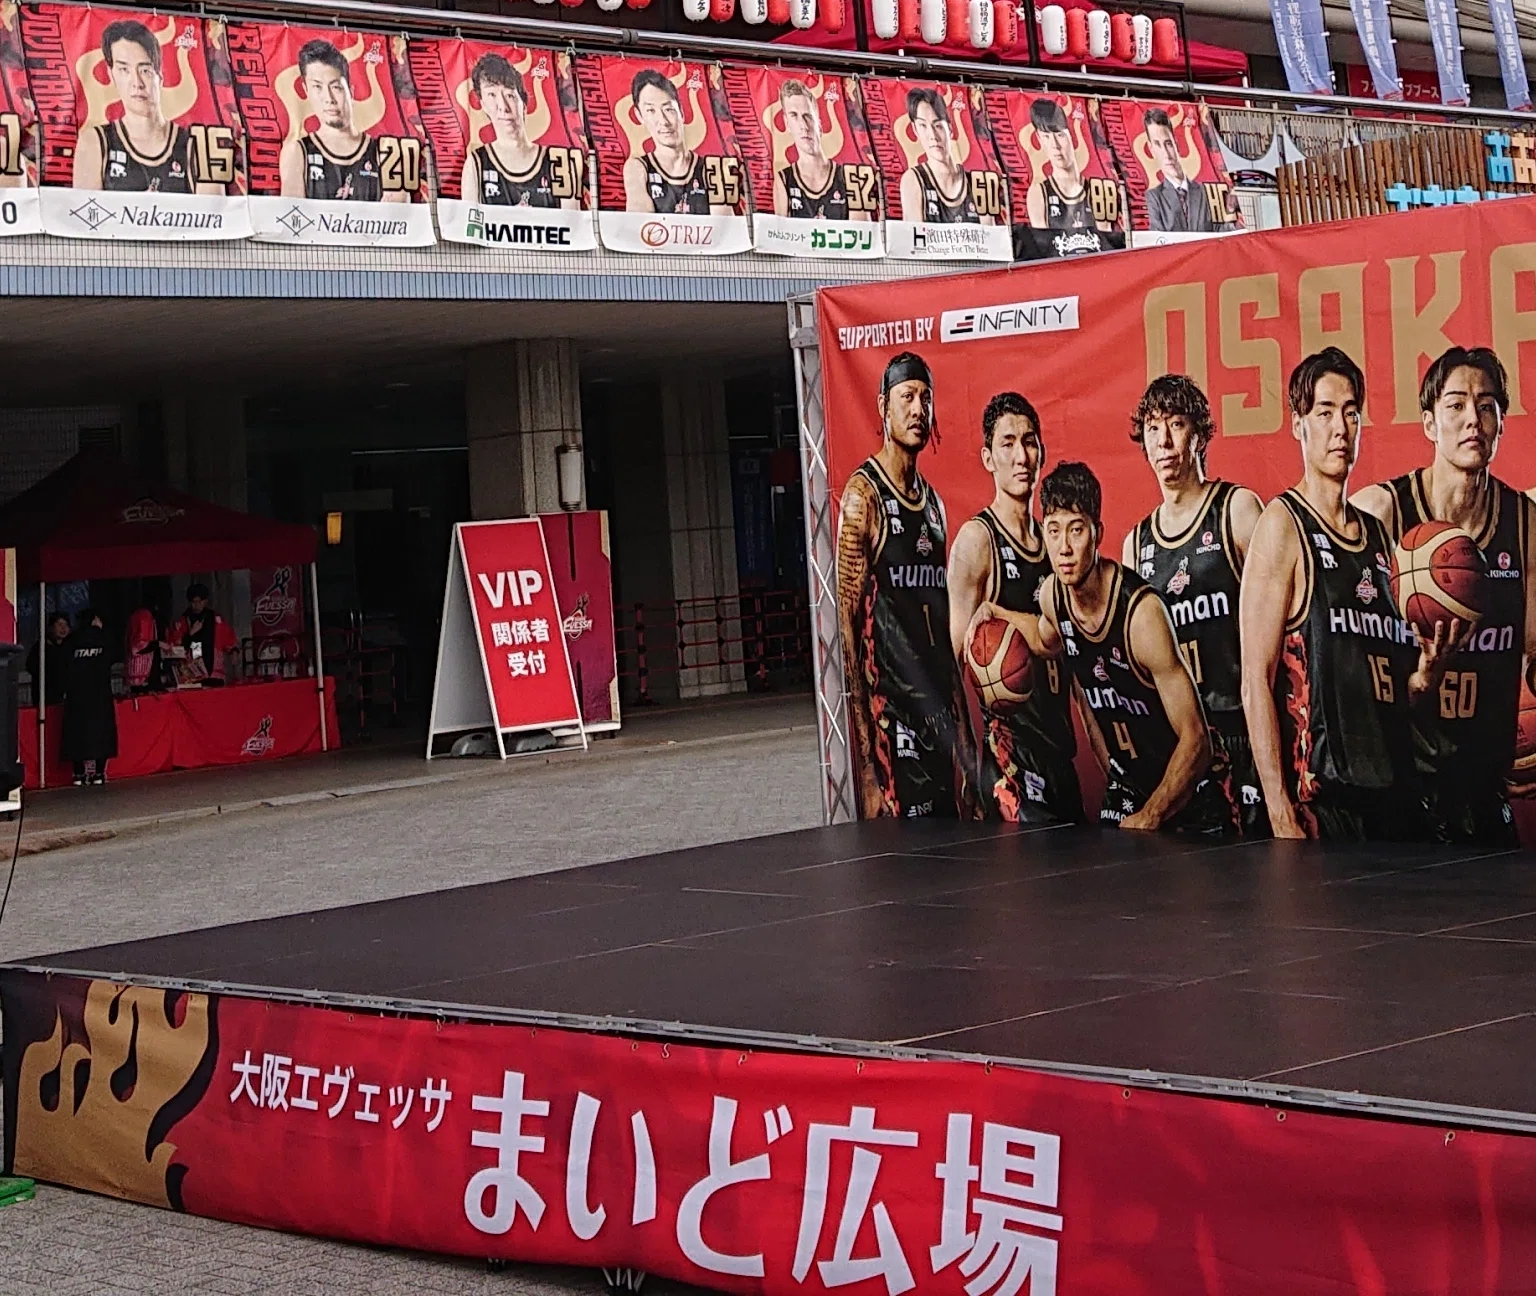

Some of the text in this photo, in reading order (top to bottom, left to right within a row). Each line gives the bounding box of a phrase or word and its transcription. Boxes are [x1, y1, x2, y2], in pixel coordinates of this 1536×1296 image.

[228, 25, 283, 192] REI GODA
[413, 39, 466, 197] MAKOTO KINOSHITA
[575, 56, 627, 208] TATSUYA SUZUKI
[189, 125, 235, 185] 15
[378, 135, 421, 193] 20
[549, 147, 584, 200] 31
[704, 156, 740, 205] 35
[844, 164, 878, 211] 52
[971, 170, 1001, 216] 60
[1089, 177, 1116, 223] 88
[119, 205, 224, 230] Nakamura
[317, 212, 409, 236] Nakamura
[484, 222, 572, 245] HAMTEC
[670, 224, 714, 245] TRIZ
[811, 228, 873, 250] カンプリ
[838, 316, 935, 350] SUPPORTED BY
[978, 302, 1069, 331] INFINITY
[477, 569, 544, 609] VIP
[888, 564, 947, 589] Huma
[1489, 568, 1520, 579] KINCHO
[1170, 590, 1230, 628] man
[491, 618, 551, 649] 関係者
[507, 651, 547, 679] 受付
[1367, 654, 1395, 703] 15
[1083, 684, 1152, 717] uman
[1438, 671, 1479, 720] 60
[1111, 720, 1138, 761] 4
[229, 1049, 454, 1132] 大阪エヴェッサ
[463, 1068, 1065, 1296] まいど広場
